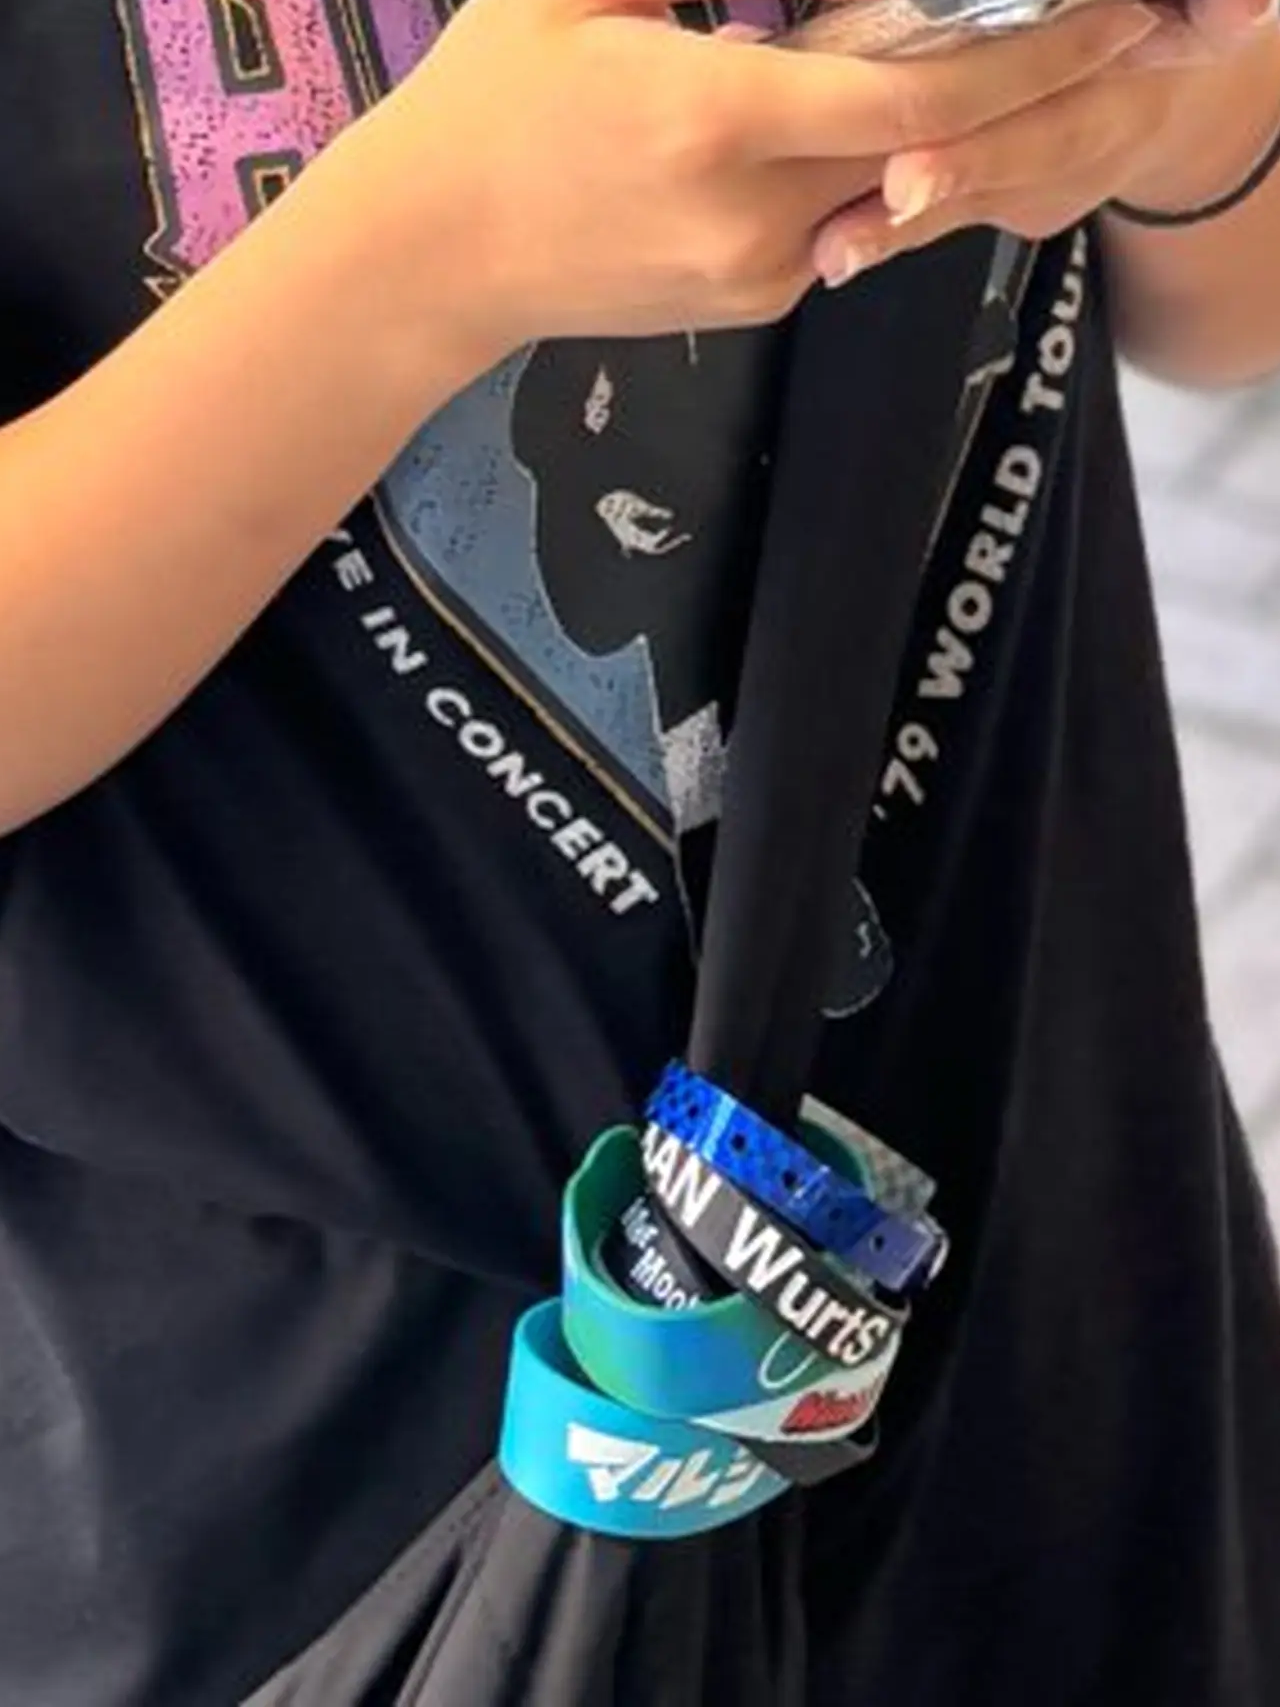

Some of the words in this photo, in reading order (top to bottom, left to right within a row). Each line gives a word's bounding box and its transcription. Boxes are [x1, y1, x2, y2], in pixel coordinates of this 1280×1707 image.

[917, 444, 1042, 700] WORLD
[360, 605, 429, 675] IN
[425, 687, 660, 915] CONCERT
